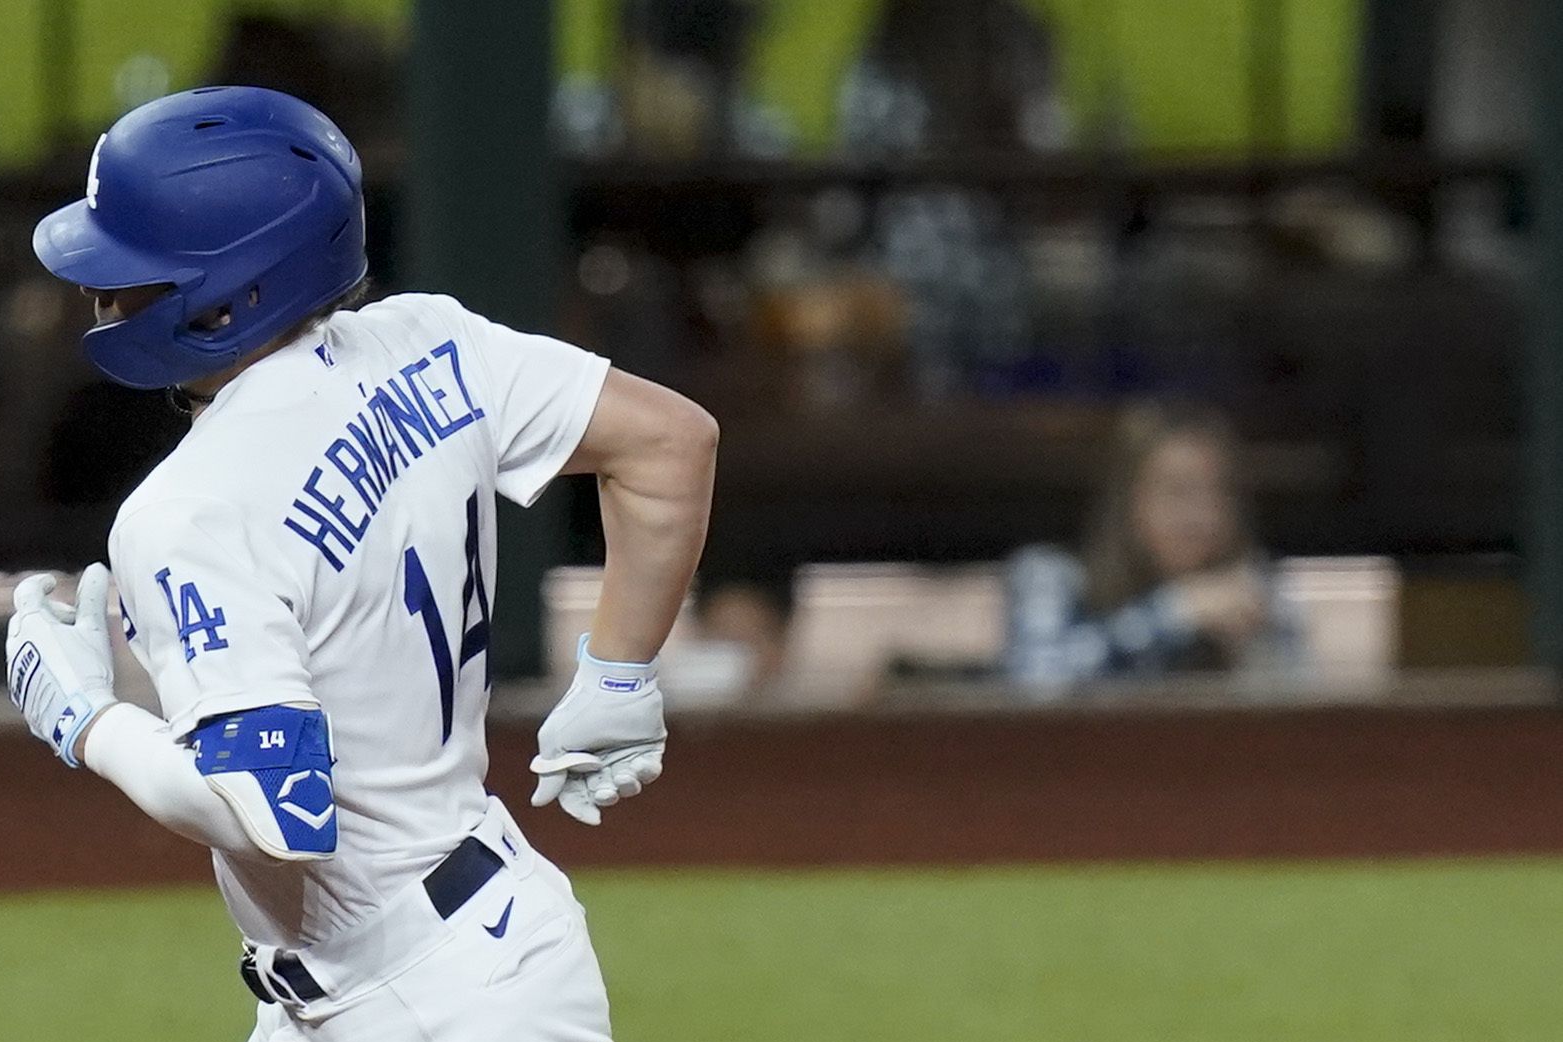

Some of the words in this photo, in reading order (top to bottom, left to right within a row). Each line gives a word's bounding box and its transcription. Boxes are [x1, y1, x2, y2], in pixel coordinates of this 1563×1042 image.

[154, 566, 229, 663] LA
[403, 483, 495, 747] 14
[258, 730, 286, 749] 14
